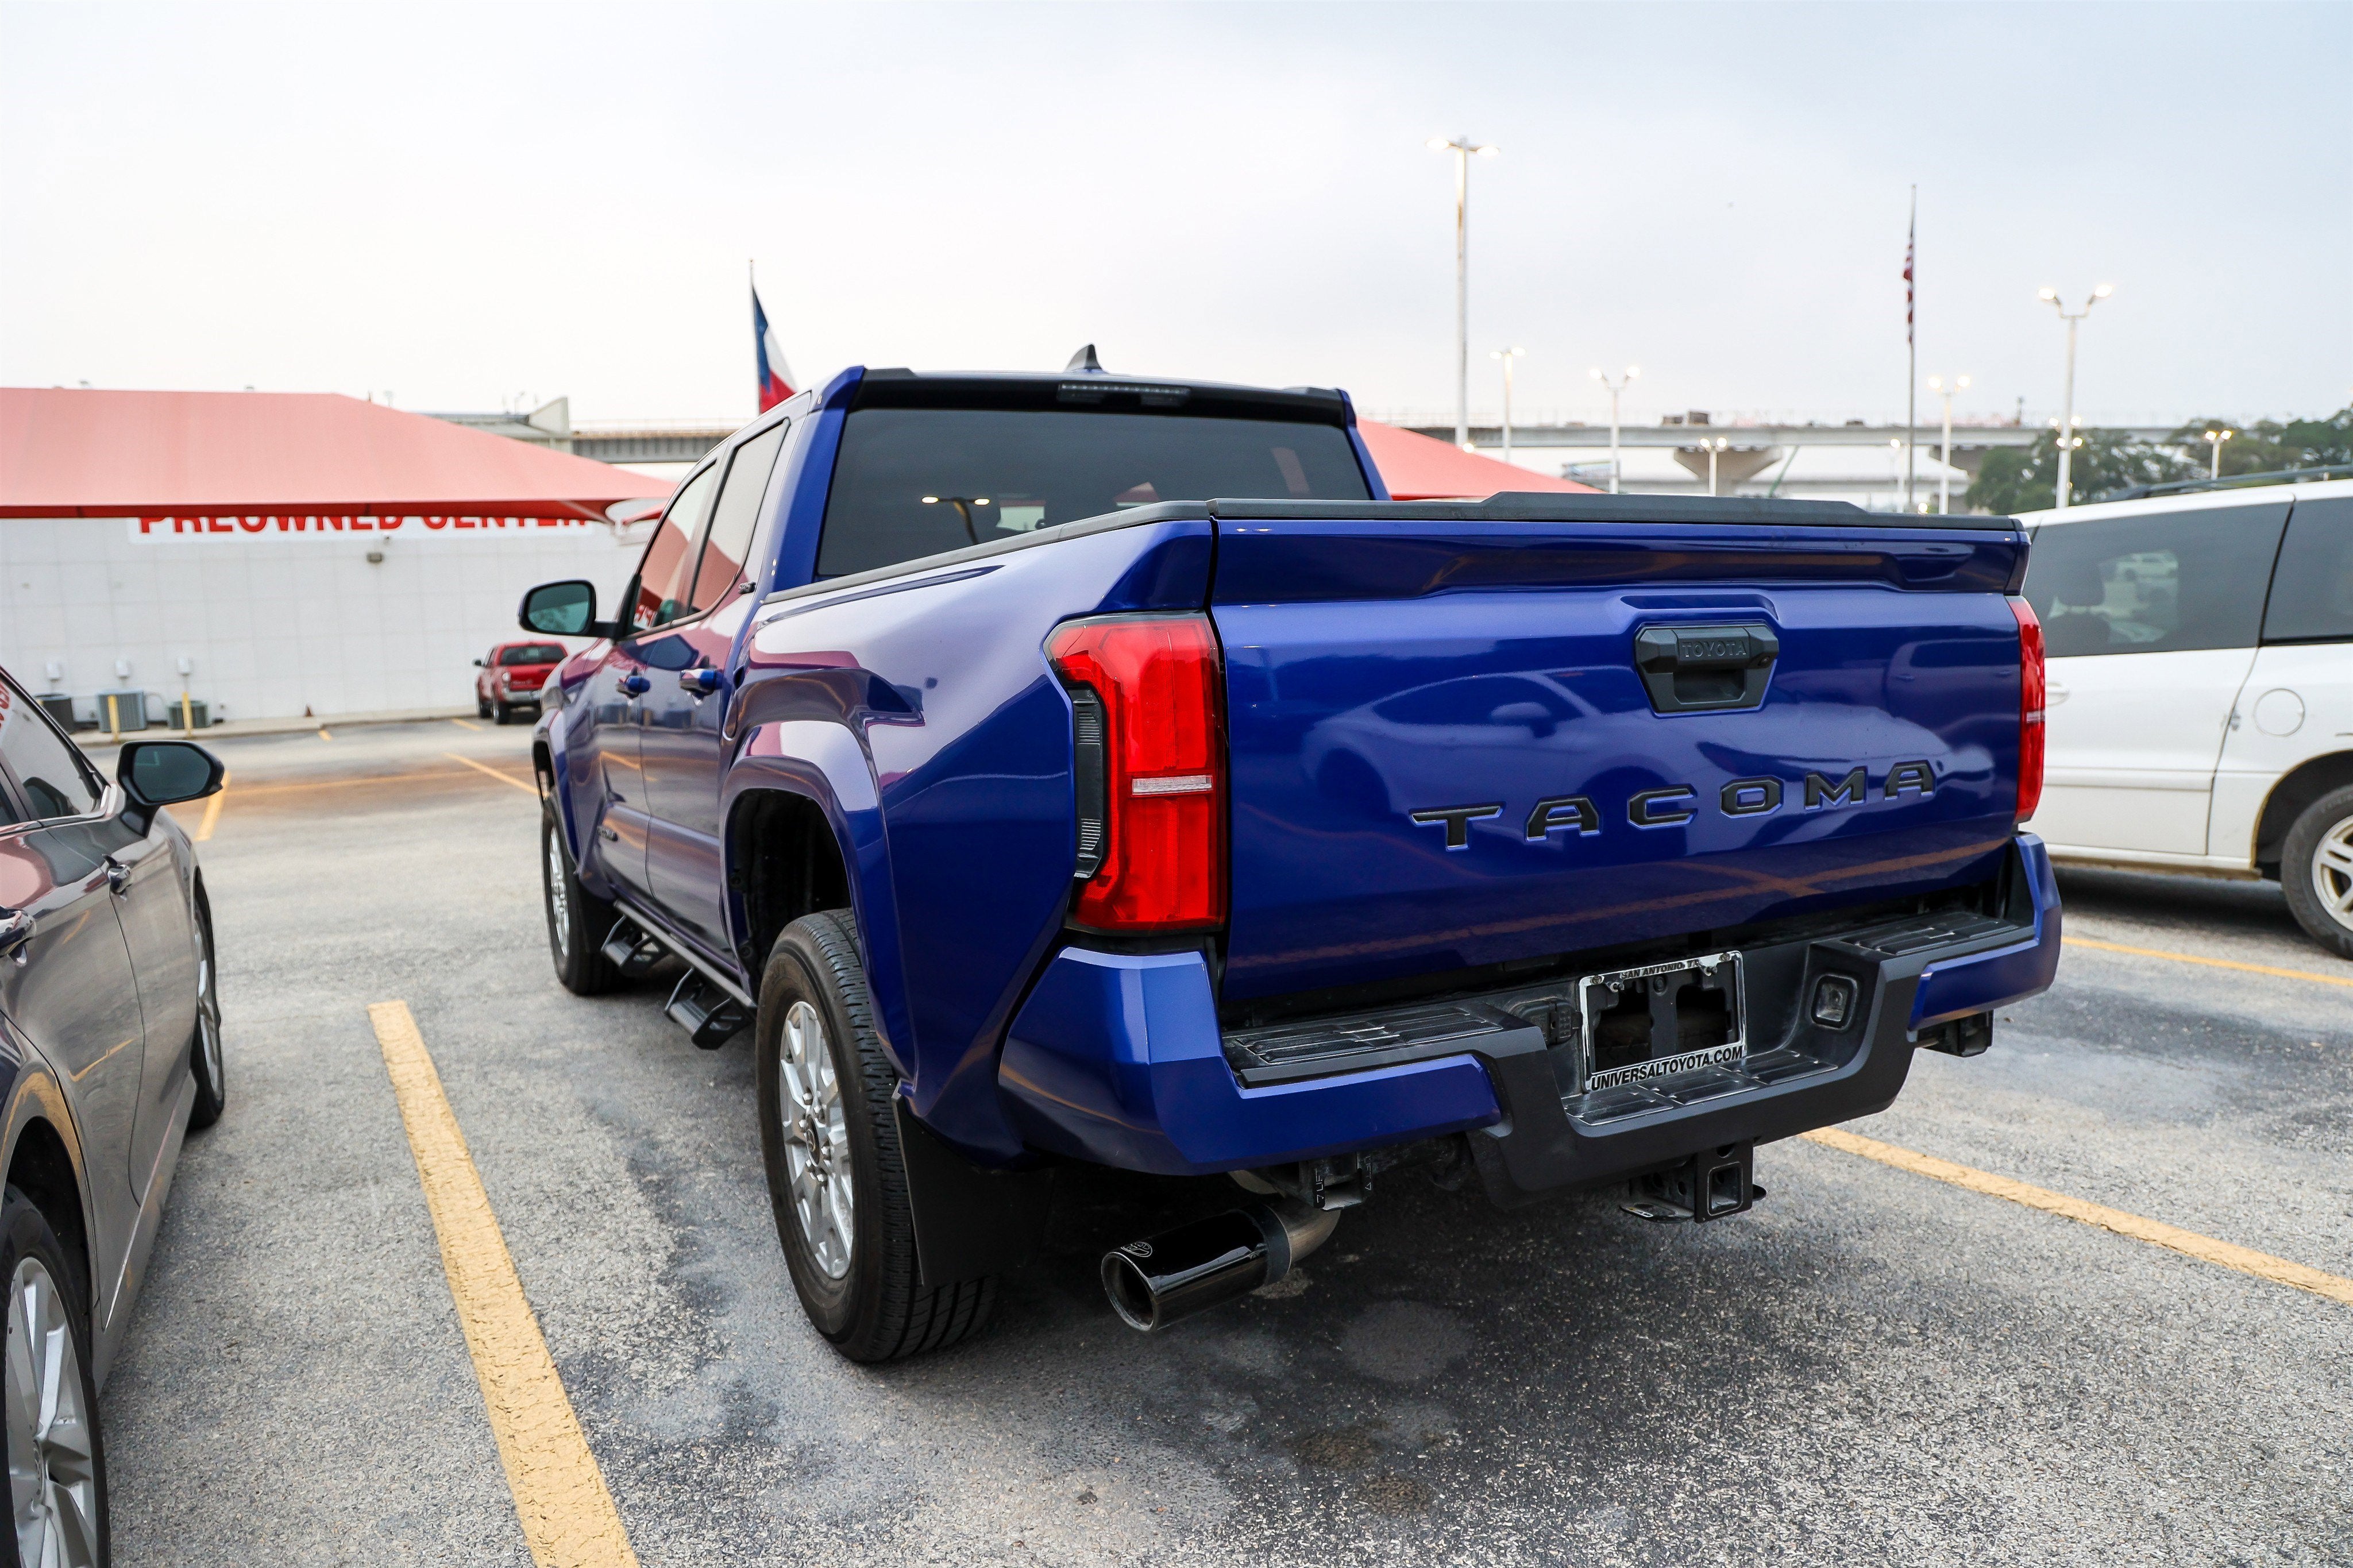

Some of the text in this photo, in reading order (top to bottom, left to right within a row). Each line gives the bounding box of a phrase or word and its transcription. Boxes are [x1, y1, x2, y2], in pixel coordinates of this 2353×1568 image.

[1682, 640, 1746, 657] TOYOTA
[1409, 759, 1937, 851] TACOMA
[1621, 969, 1641, 979] SAN
[1590, 1045, 1743, 1091] UNIVERSALTOYOTA.COM
